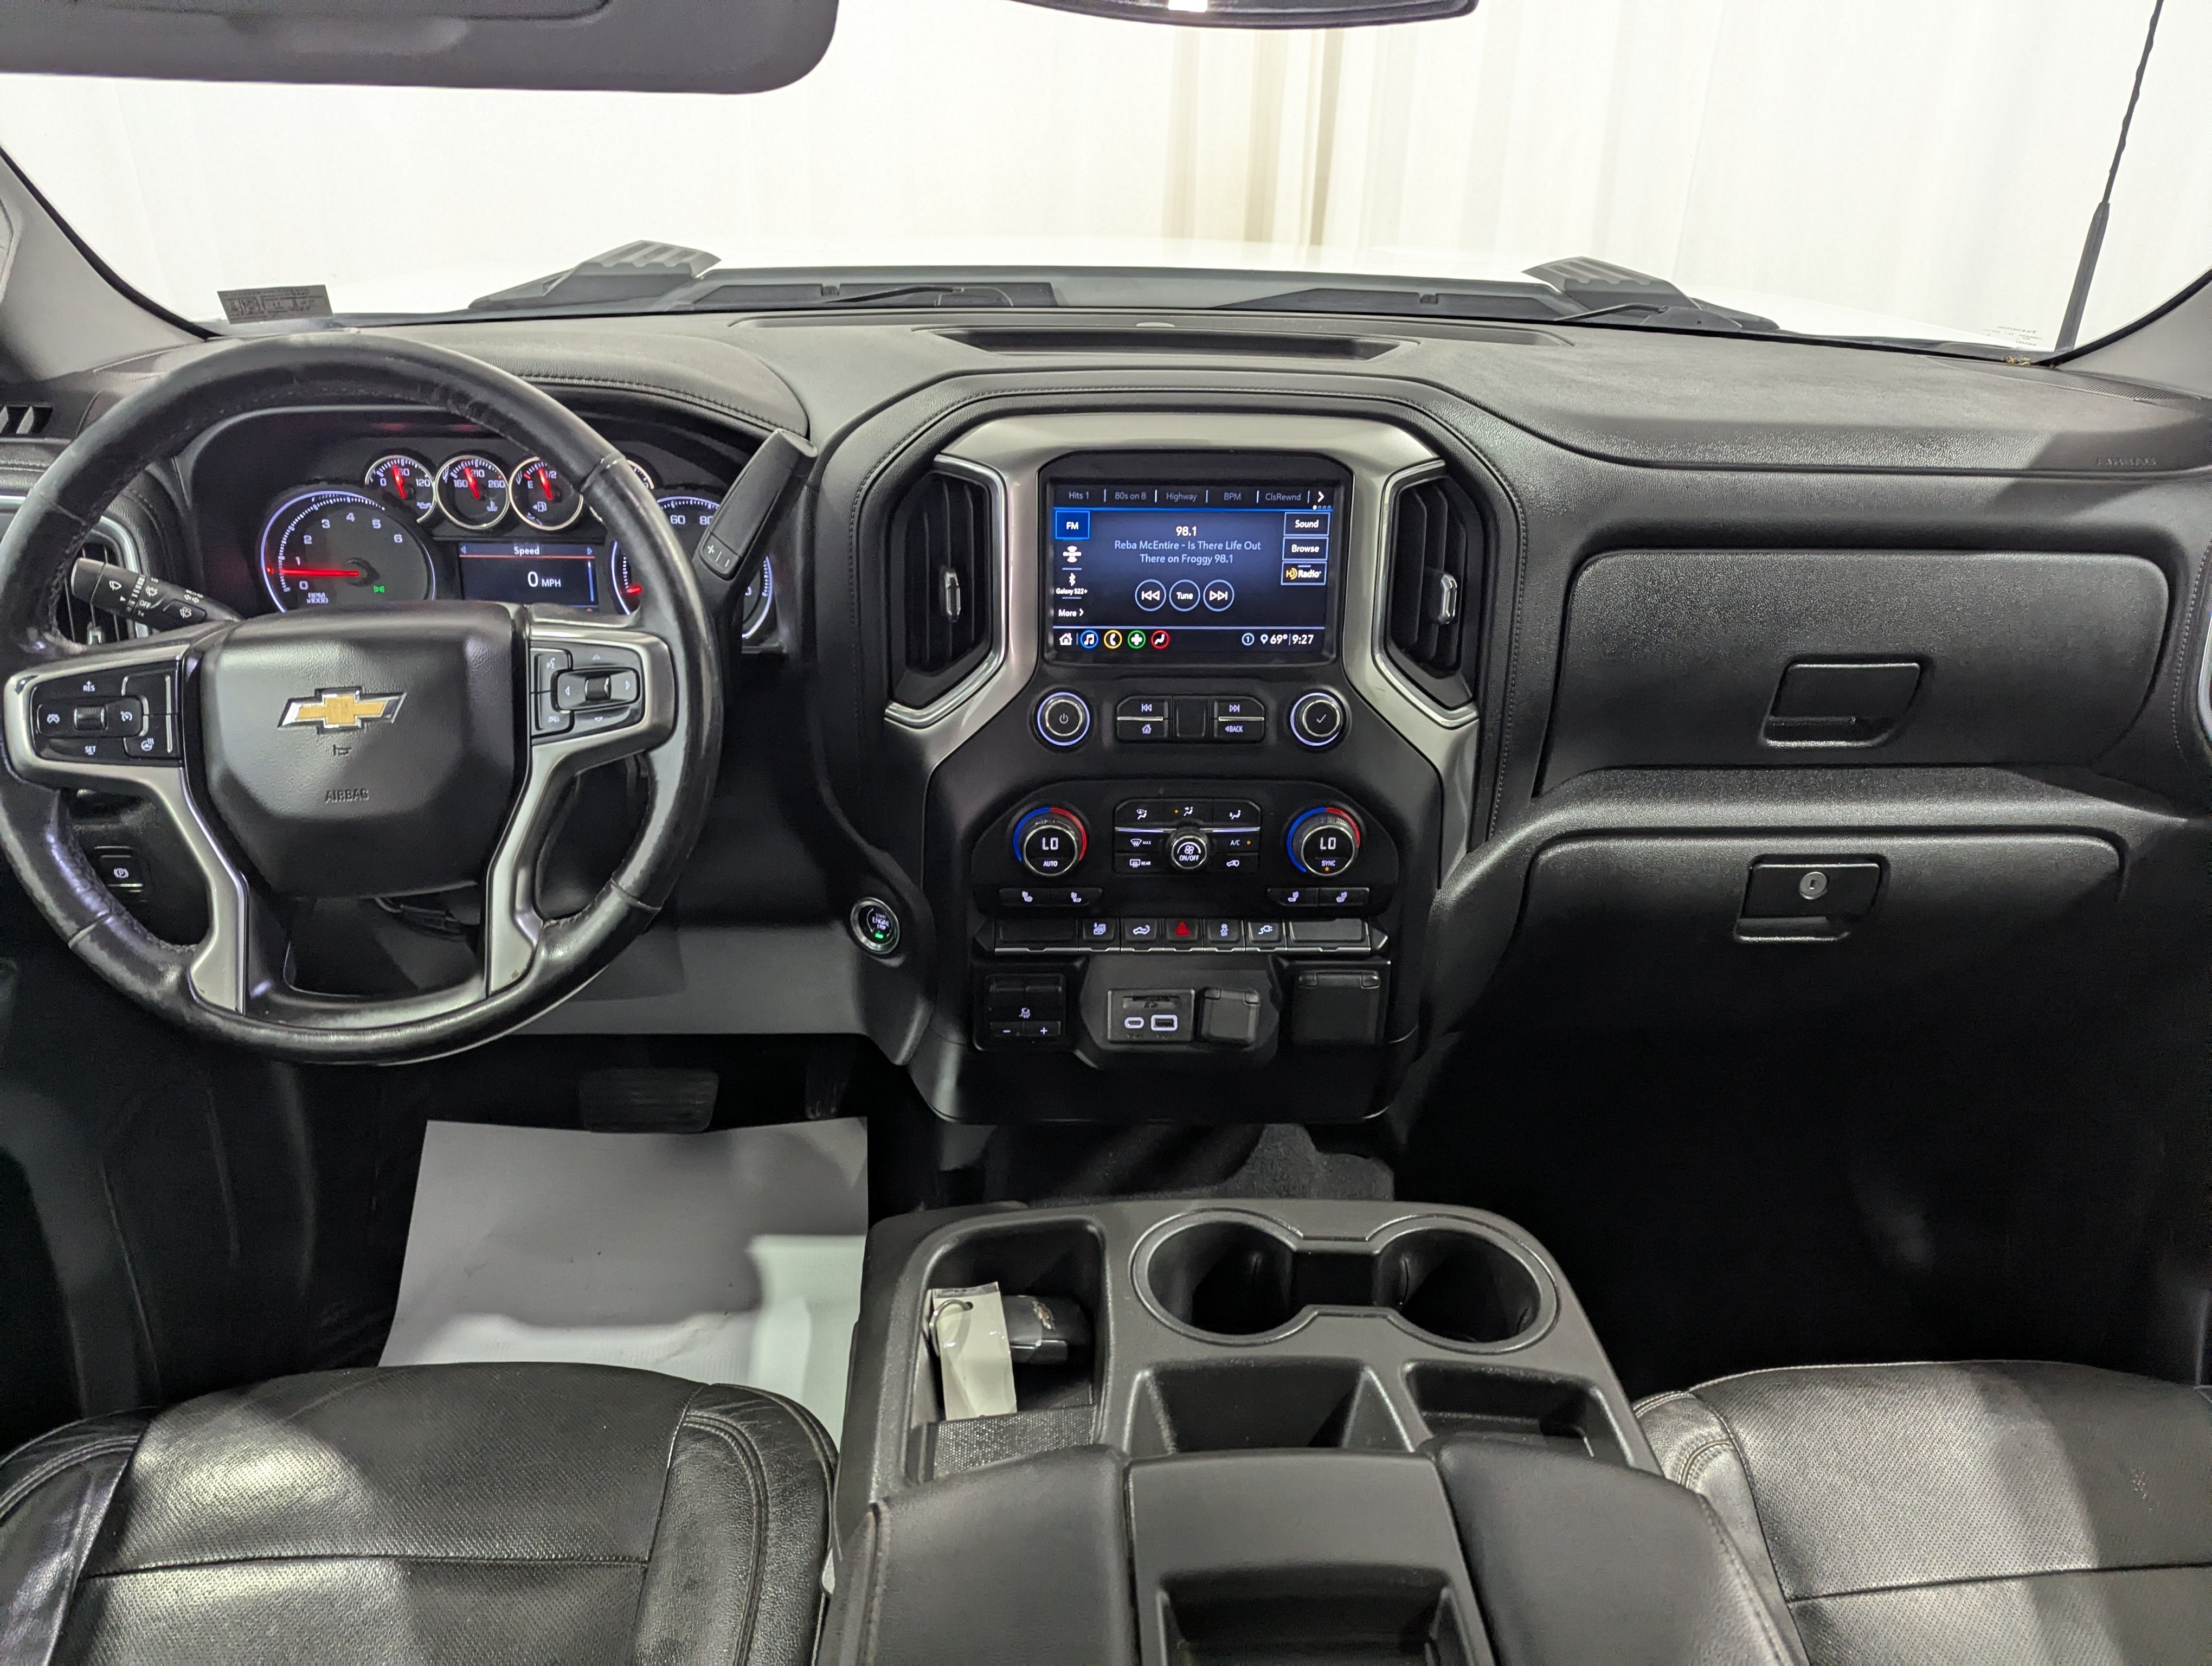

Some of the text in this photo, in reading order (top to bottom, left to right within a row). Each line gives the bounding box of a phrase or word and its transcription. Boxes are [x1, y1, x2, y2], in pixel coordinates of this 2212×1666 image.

[545, 470, 557, 479] 1/2
[380, 478, 387, 486] 0
[416, 478, 430, 487] 120
[454, 479, 468, 488] 160
[488, 479, 505, 488] 260
[528, 480, 533, 489] E
[1069, 491, 1089, 499] Hits 1
[1166, 492, 1198, 502] Highway
[1224, 492, 1241, 501] BPM
[1265, 493, 1301, 501] ClsRewnd
[346, 512, 355, 522] 4
[670, 515, 686, 524] 60
[321, 519, 331, 529] 3
[372, 519, 381, 529] 5
[1066, 521, 1079, 530] FM
[1295, 520, 1319, 528] Sound
[1176, 526, 1197, 536] 98.1
[303, 535, 312, 544] 2
[394, 534, 403, 543] 6
[1114, 540, 1137, 550] Reba
[1139, 540, 1179, 550] McEntire
[1188, 541, 1195, 550] Is
[1197, 541, 1224, 550] There
[1225, 540, 1242, 550] Life
[1244, 541, 1261, 550] Out
[1291, 544, 1320, 553] Browse
[513, 546, 540, 557] Speed
[295, 556, 301, 566] 1
[1140, 554, 1166, 563] There
[1181, 554, 1213, 566] Froggy
[1214, 554, 1233, 563] 98.1
[528, 571, 561, 587] 0 MPH
[299, 581, 308, 590] 0
[1056, 588, 1073, 596] Galaxy
[1176, 592, 1193, 600] Tune
[139, 600, 151, 608] OFF
[1058, 609, 1077, 617] More
[1270, 634, 1288, 644] 69°
[1292, 634, 1314, 644] 9:27
[325, 788, 369, 803] AIRBAG
[1042, 837, 1059, 850] LO
[1320, 837, 1336, 850] LO
